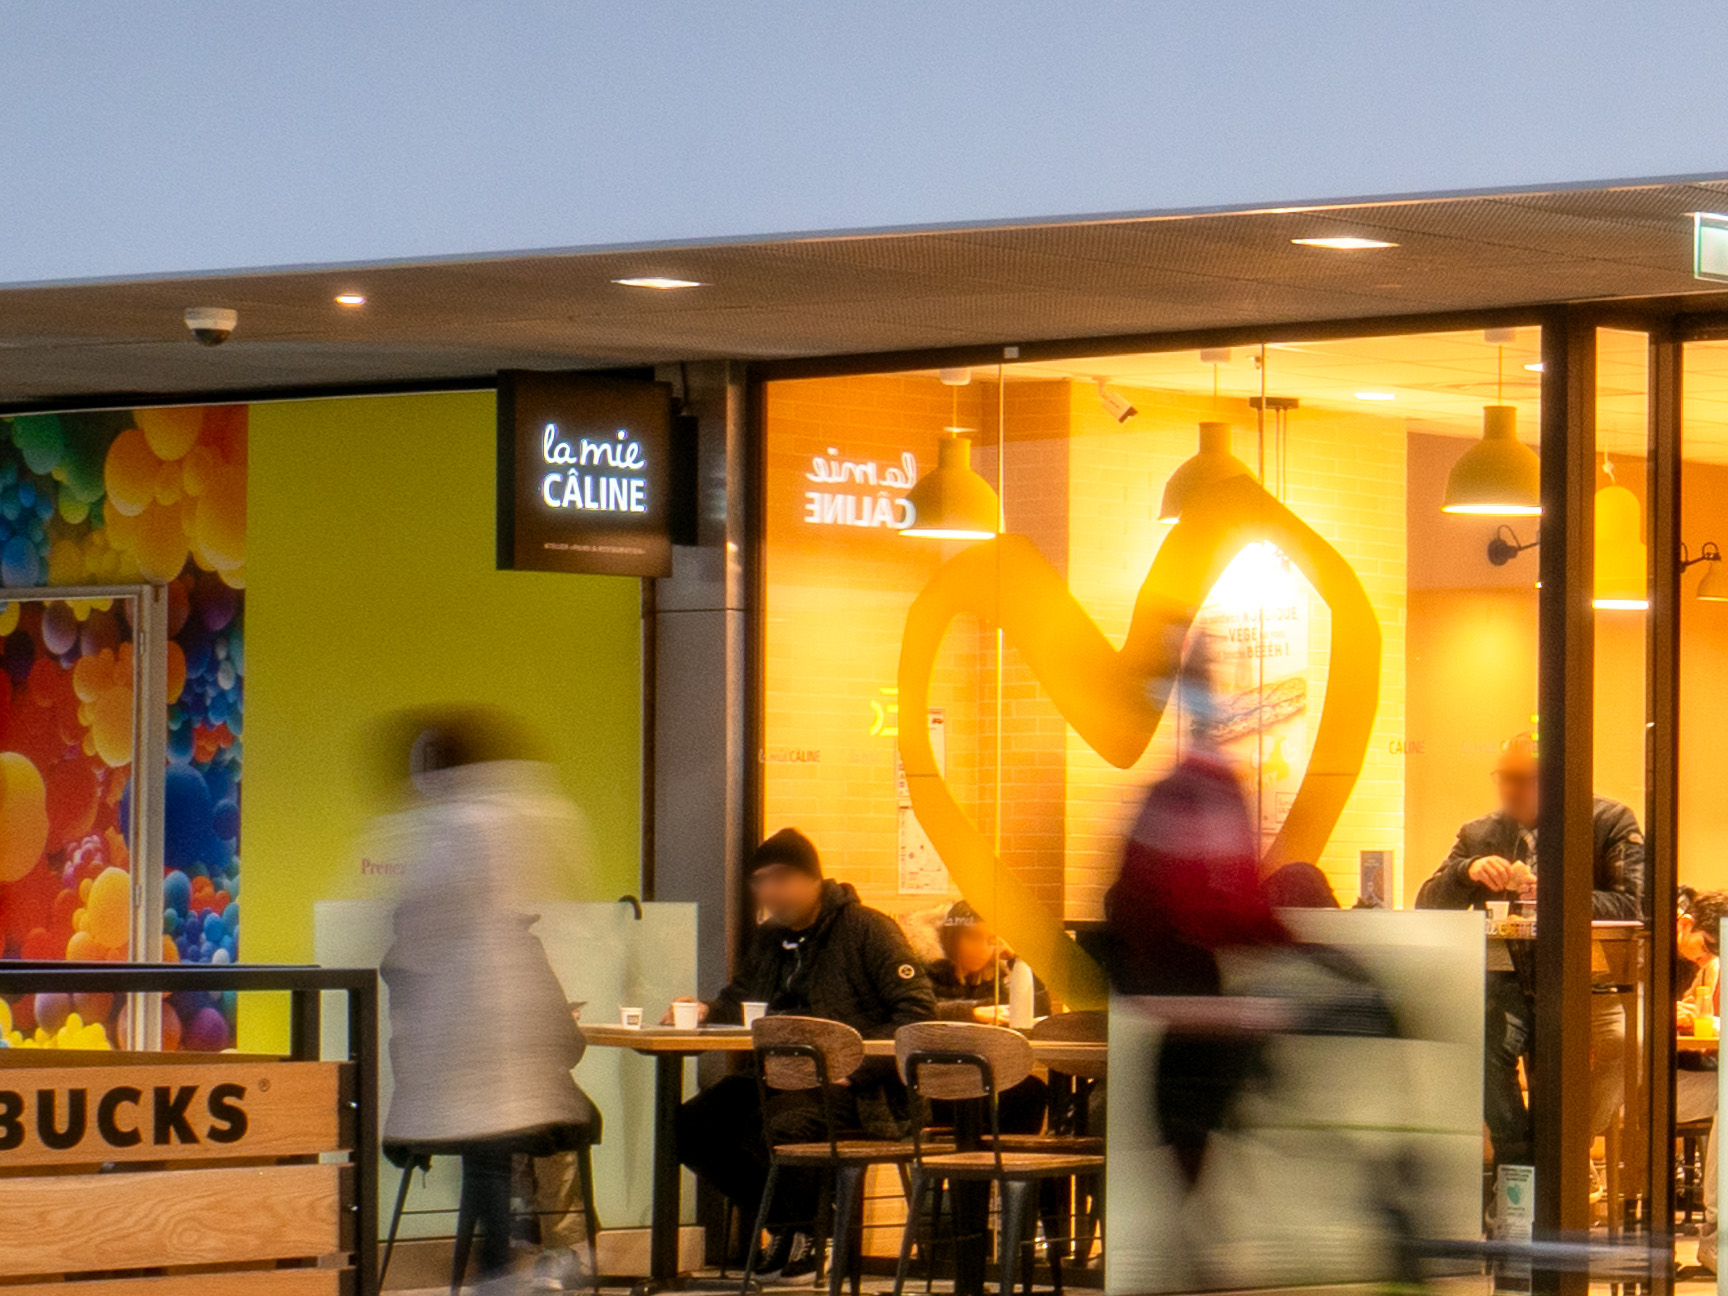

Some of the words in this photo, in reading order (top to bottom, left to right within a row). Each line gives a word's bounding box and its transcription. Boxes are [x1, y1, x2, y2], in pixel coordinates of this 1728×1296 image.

[542, 423, 578, 464] la
[579, 429, 647, 469] mie
[542, 467, 648, 513] CÂLINE
